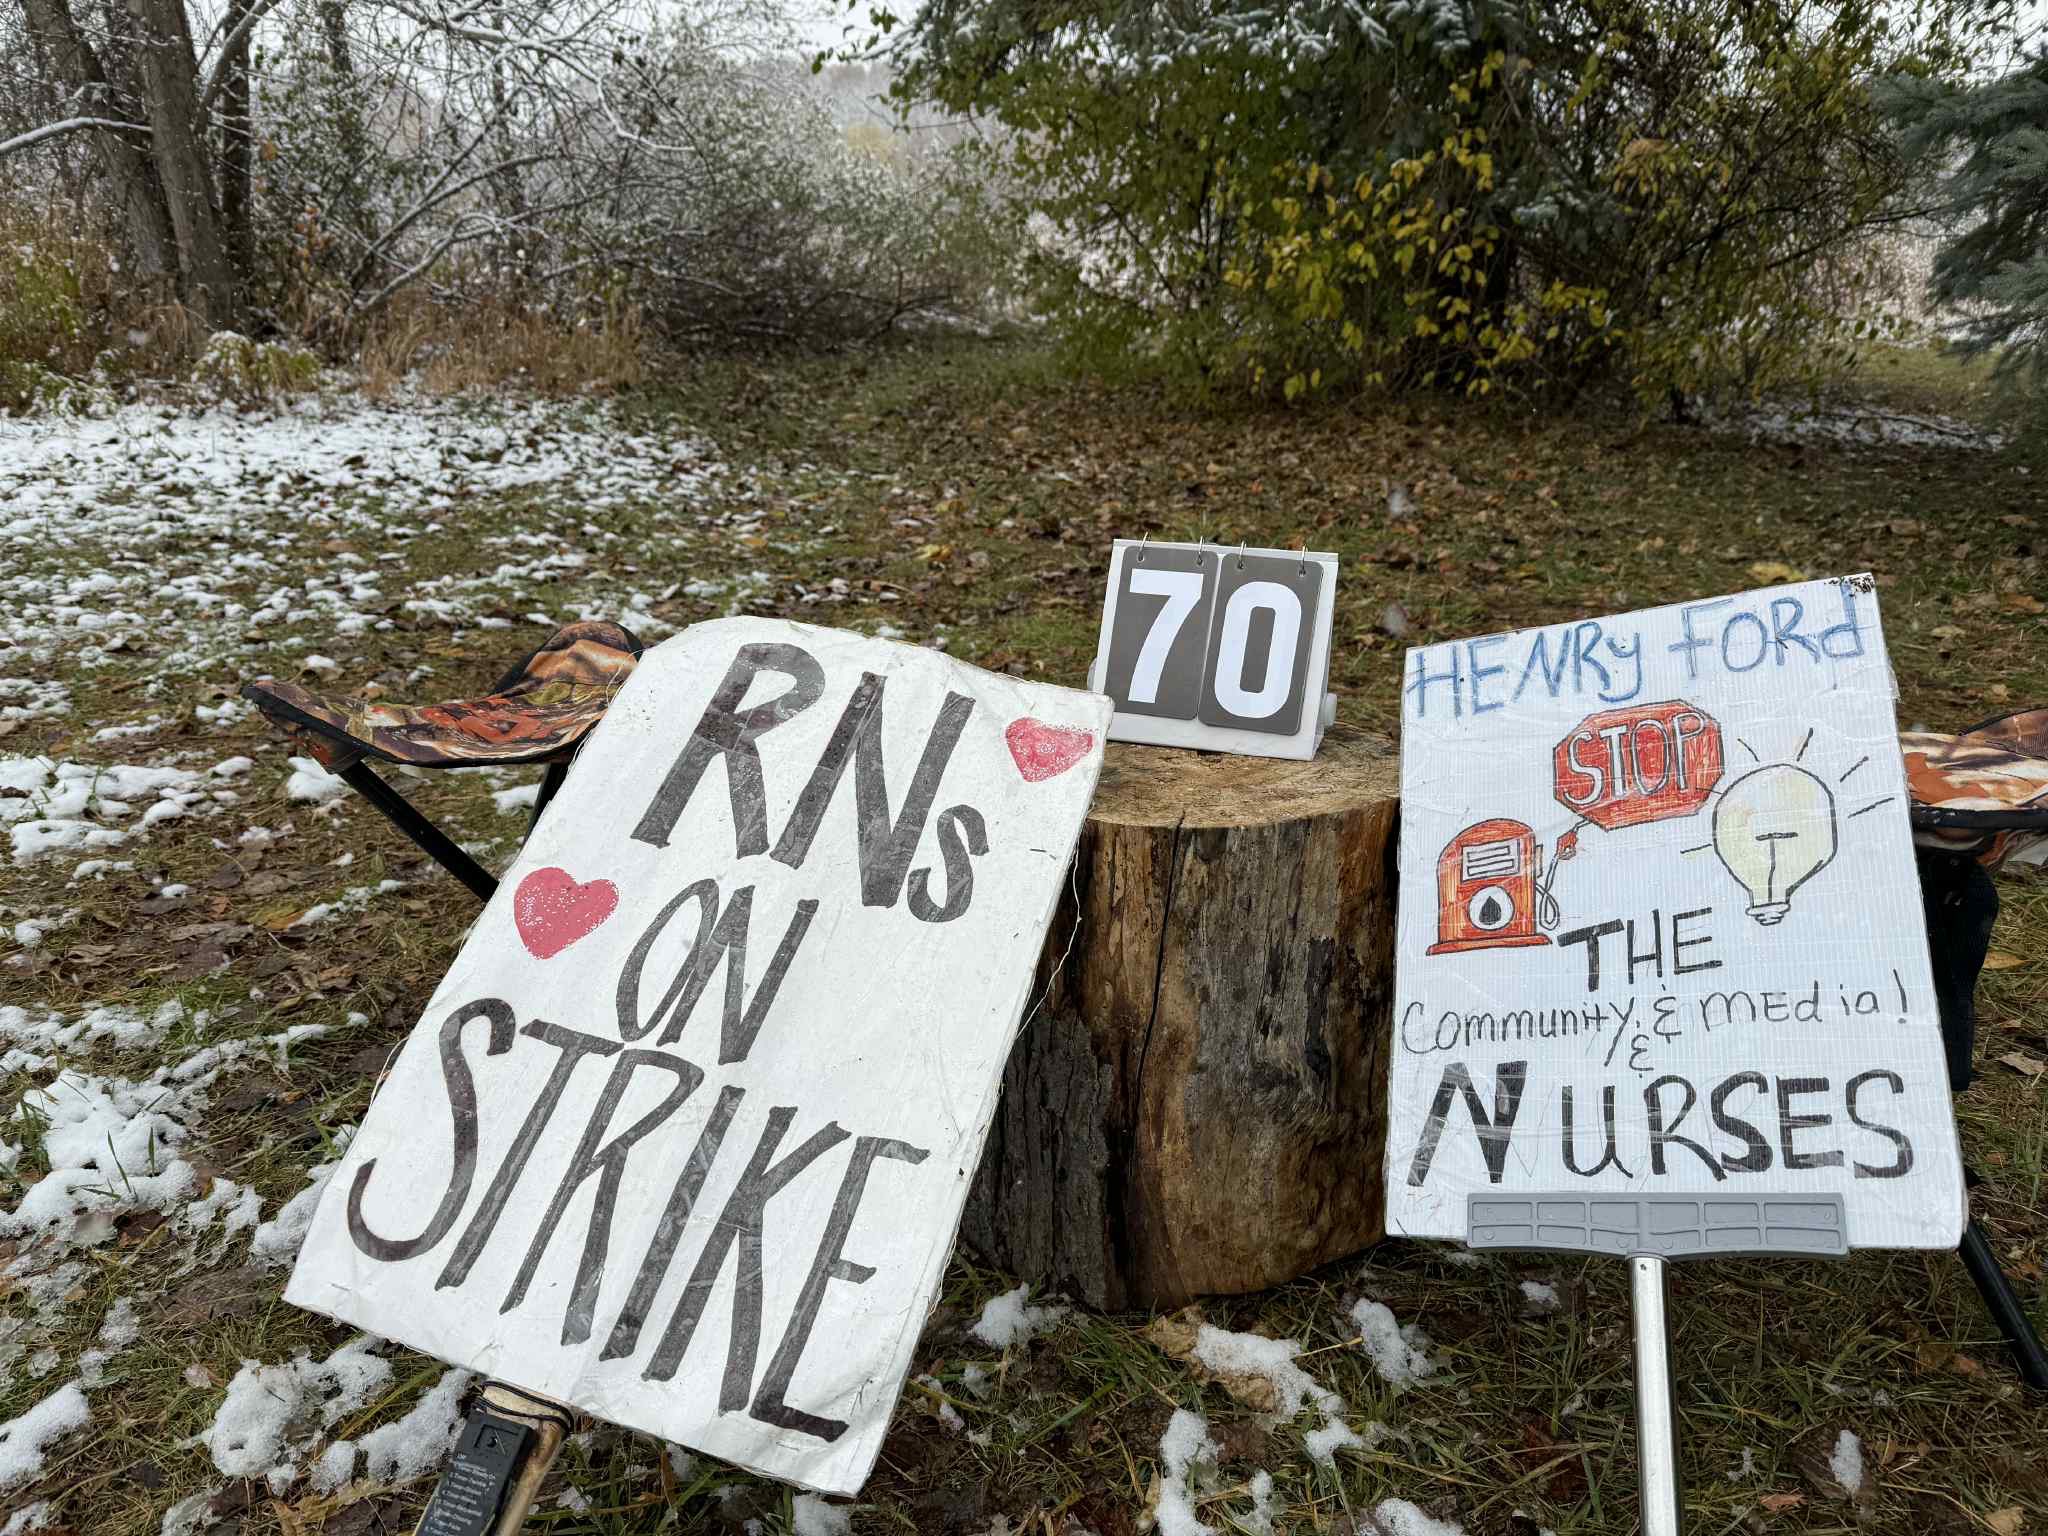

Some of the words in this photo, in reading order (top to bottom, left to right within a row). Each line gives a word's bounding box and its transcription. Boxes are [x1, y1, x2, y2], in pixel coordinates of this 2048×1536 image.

[1128, 568, 1302, 719] 70
[630, 642, 990, 923] RNs
[1562, 711, 1707, 806] STOP
[616, 877, 820, 1065] ON
[1557, 907, 1722, 992] THE
[1406, 1060, 1914, 1188] NURSES
[346, 997, 931, 1443] STRIKE
